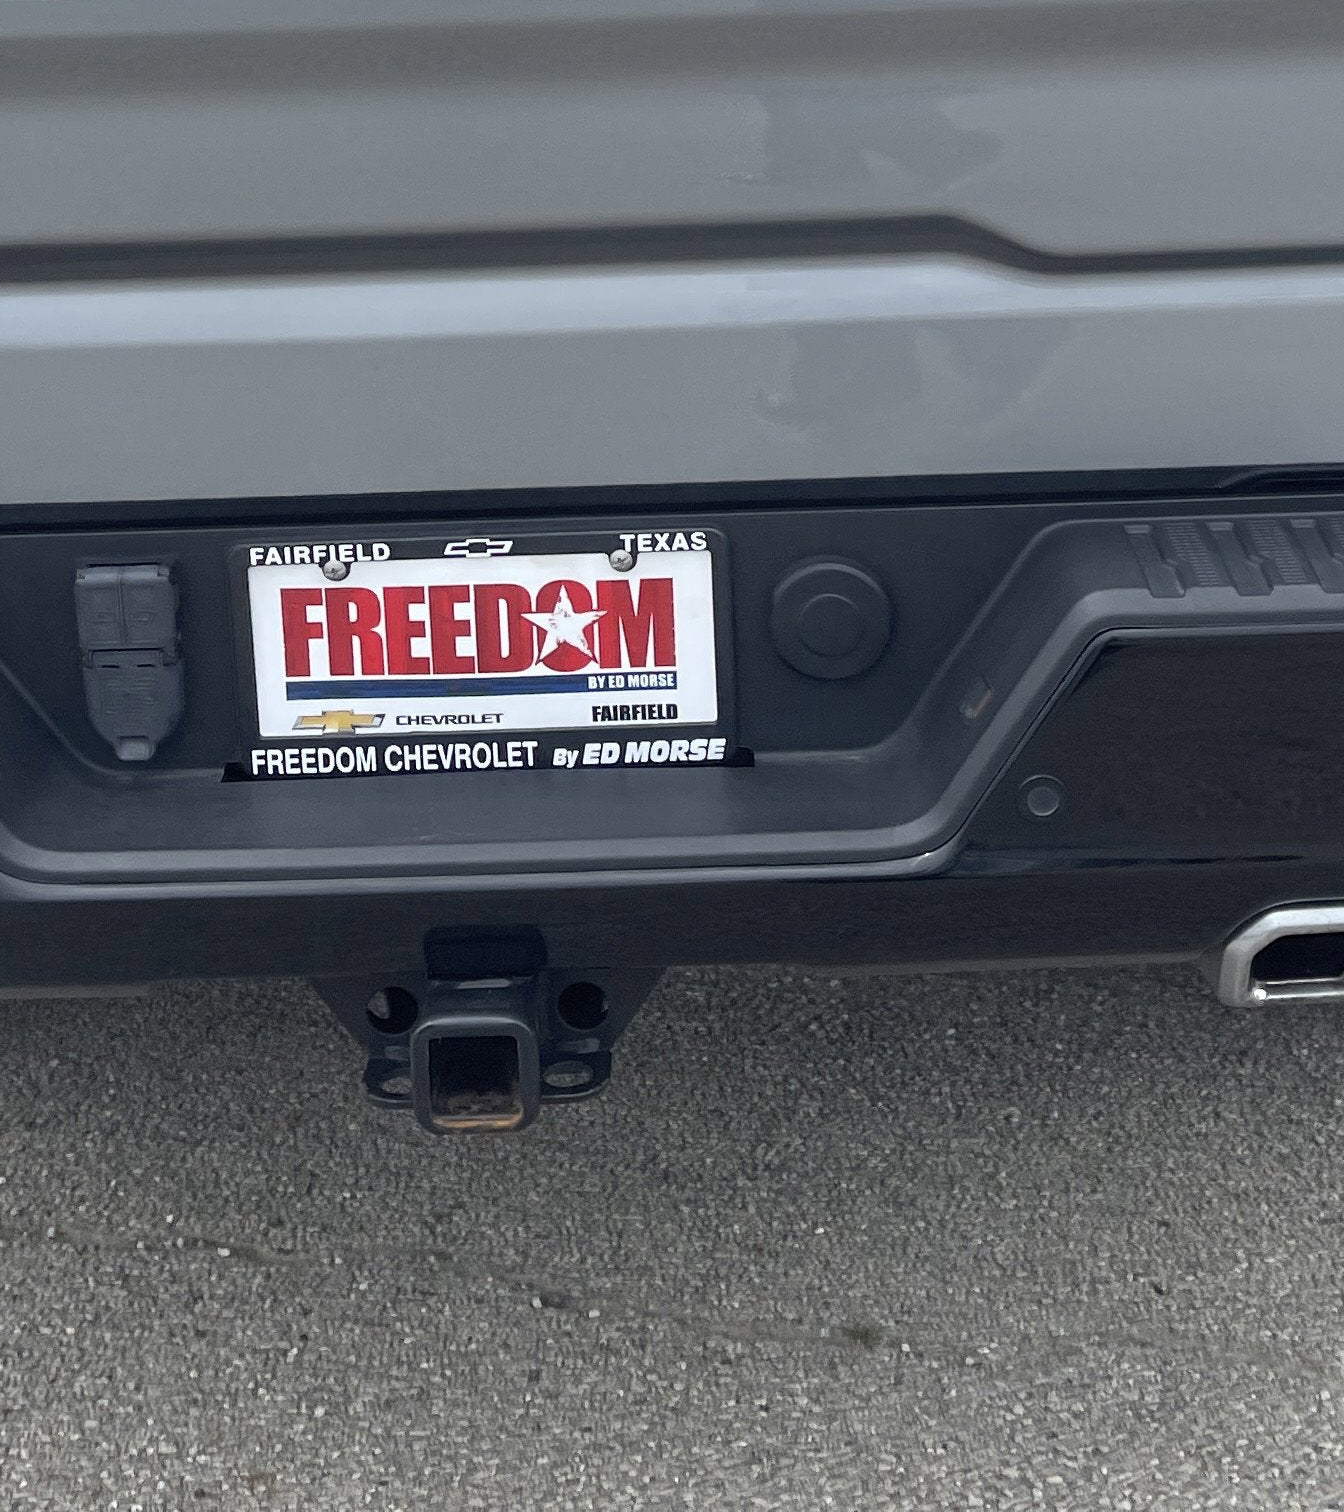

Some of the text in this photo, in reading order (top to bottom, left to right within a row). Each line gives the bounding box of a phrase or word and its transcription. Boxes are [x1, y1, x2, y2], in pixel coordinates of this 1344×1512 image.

[619, 532, 707, 553] TEXAS
[249, 542, 391, 566] FAIRFIELD
[280, 577, 677, 677] FREEDOM
[587, 672, 675, 690] BY ED MORSE
[395, 713, 504, 726] CHEVROLET
[592, 703, 678, 723] FAIRFIELD
[251, 737, 727, 776] FREEDOM CHEVROLET By ED MORSE
